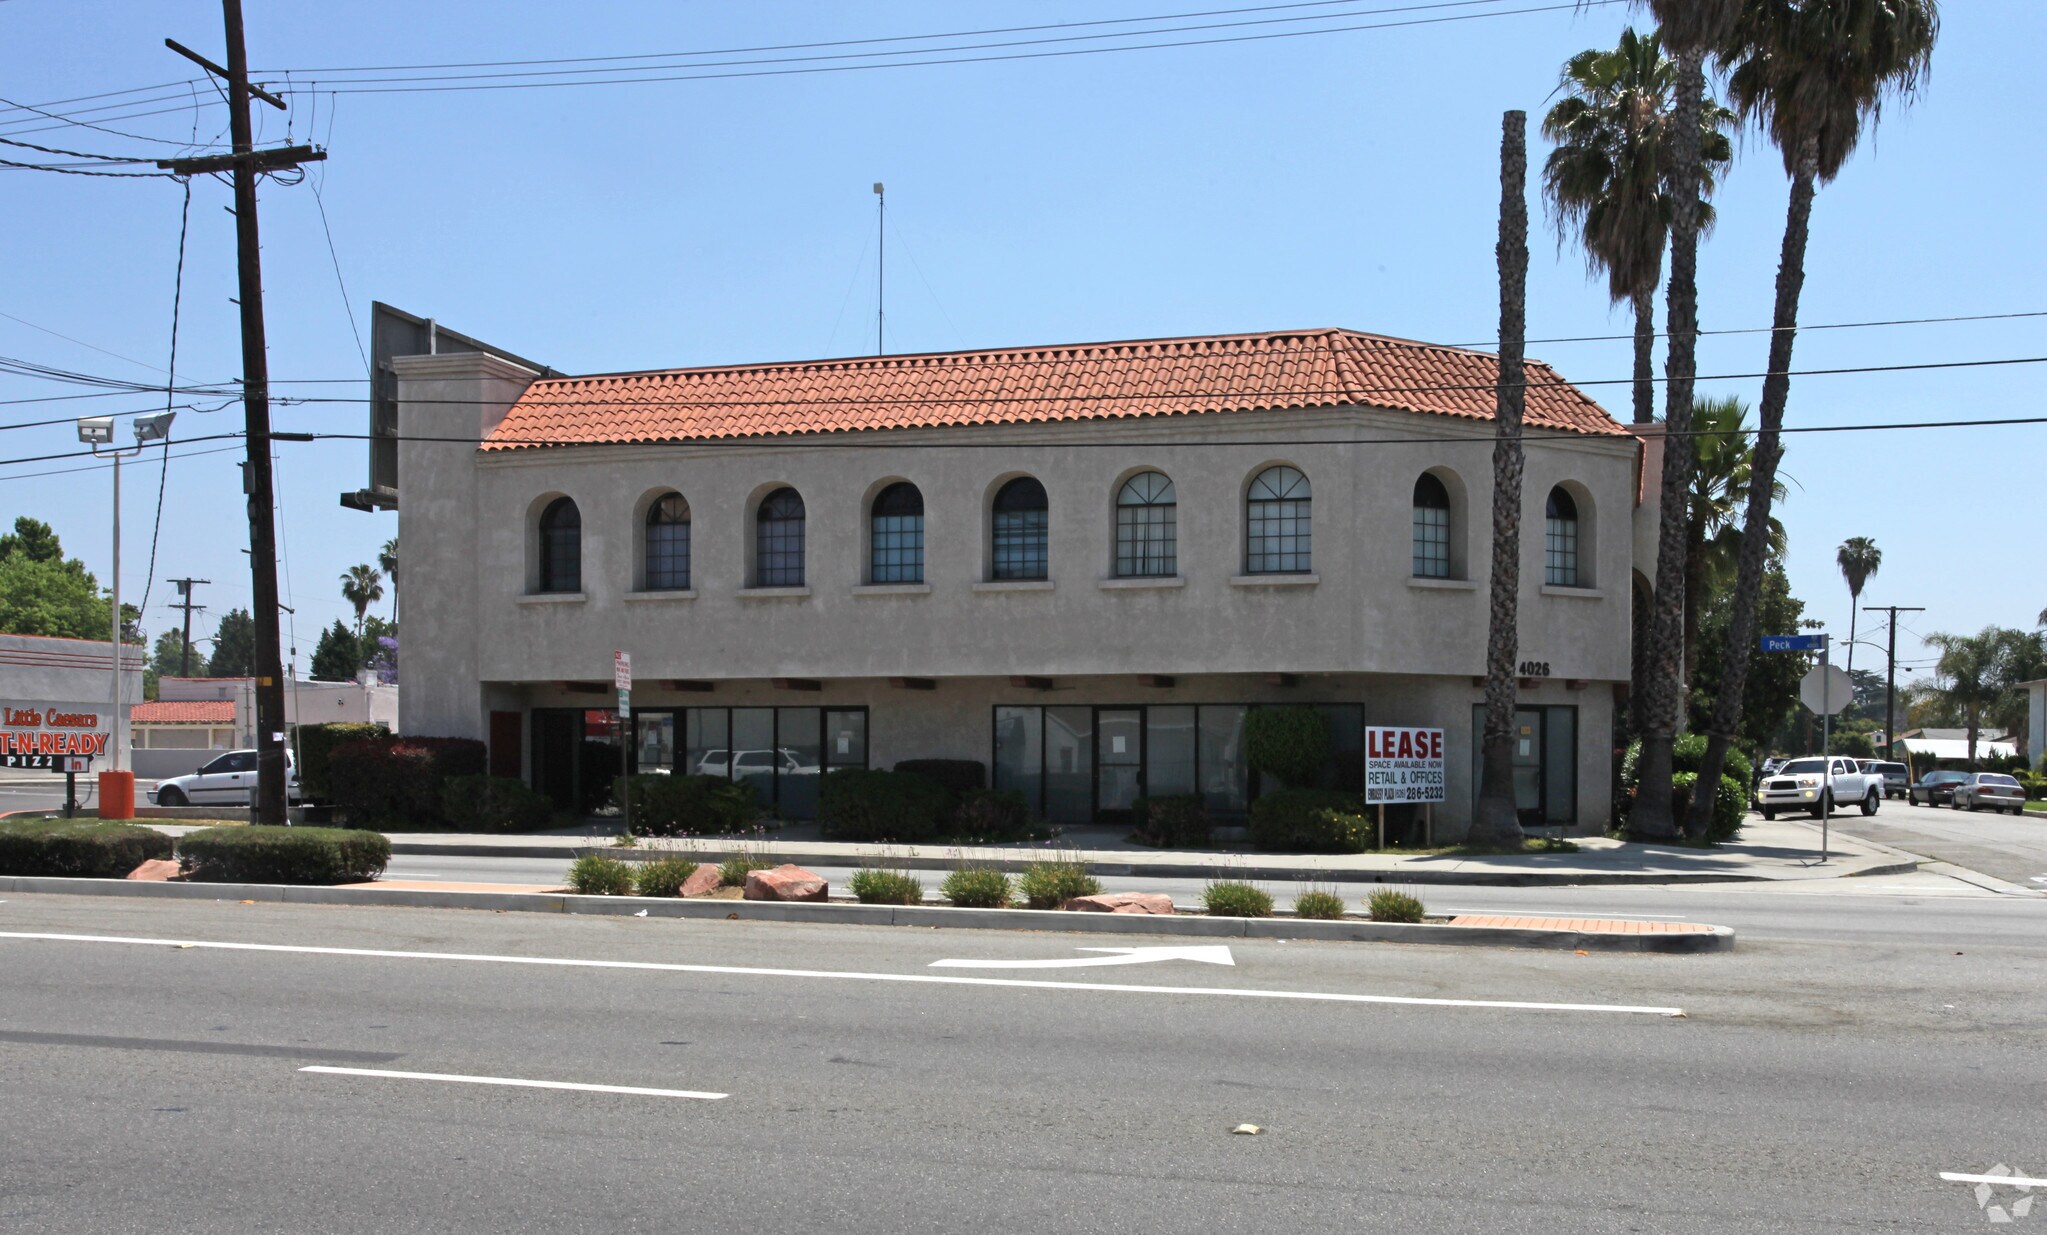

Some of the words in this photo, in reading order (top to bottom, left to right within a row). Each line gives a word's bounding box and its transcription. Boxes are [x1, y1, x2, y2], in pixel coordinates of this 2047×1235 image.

[1769, 640, 1790, 650] Peck
[1519, 661, 1550, 676] 4026
[4, 707, 41, 726] Little
[46, 708, 97, 727] Caesars
[1369, 730, 1442, 759] LEASE
[7, 756, 53, 767] PIZZ
[71, 758, 82, 770] in
[1369, 760, 1391, 769] SPACE
[1394, 760, 1426, 769] AVAILABLE
[1428, 760, 1442, 769] NOW
[1368, 771, 1397, 784] RETAIL
[1401, 771, 1407, 784] &
[1410, 771, 1442, 784] OFFICES
[1407, 786, 1443, 800] 286-5232
